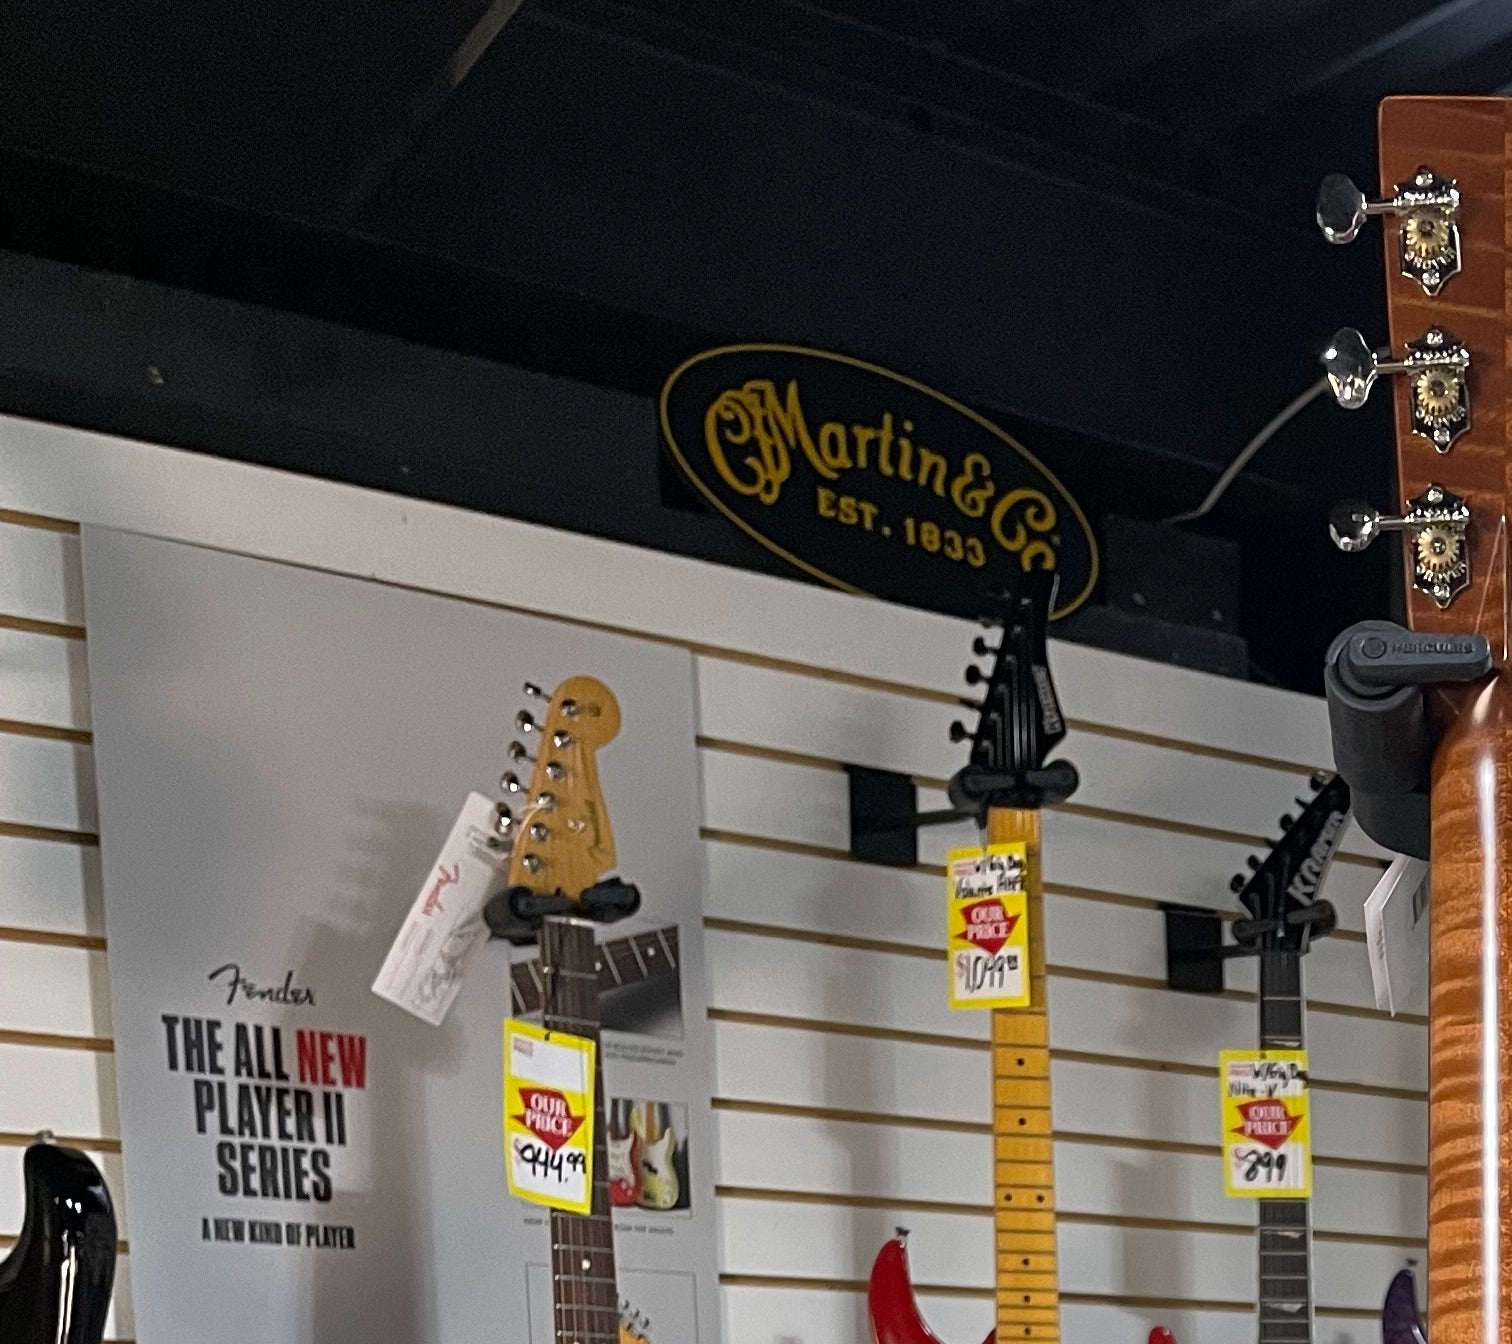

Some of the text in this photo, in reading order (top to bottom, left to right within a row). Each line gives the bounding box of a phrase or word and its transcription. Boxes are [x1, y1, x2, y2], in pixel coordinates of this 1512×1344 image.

[815, 487, 986, 568] EST. 1833
[970, 905, 1005, 924] OUR
[208, 962, 317, 1005] Fender
[161, 1014, 367, 1090] THE ALL NEW
[193, 1079, 348, 1147] PLAYER II
[524, 1107, 574, 1138] PRICE
[529, 1091, 568, 1117] OUR
[215, 1140, 334, 1204] SERIES
[306, 1224, 356, 1250] PLAYER
